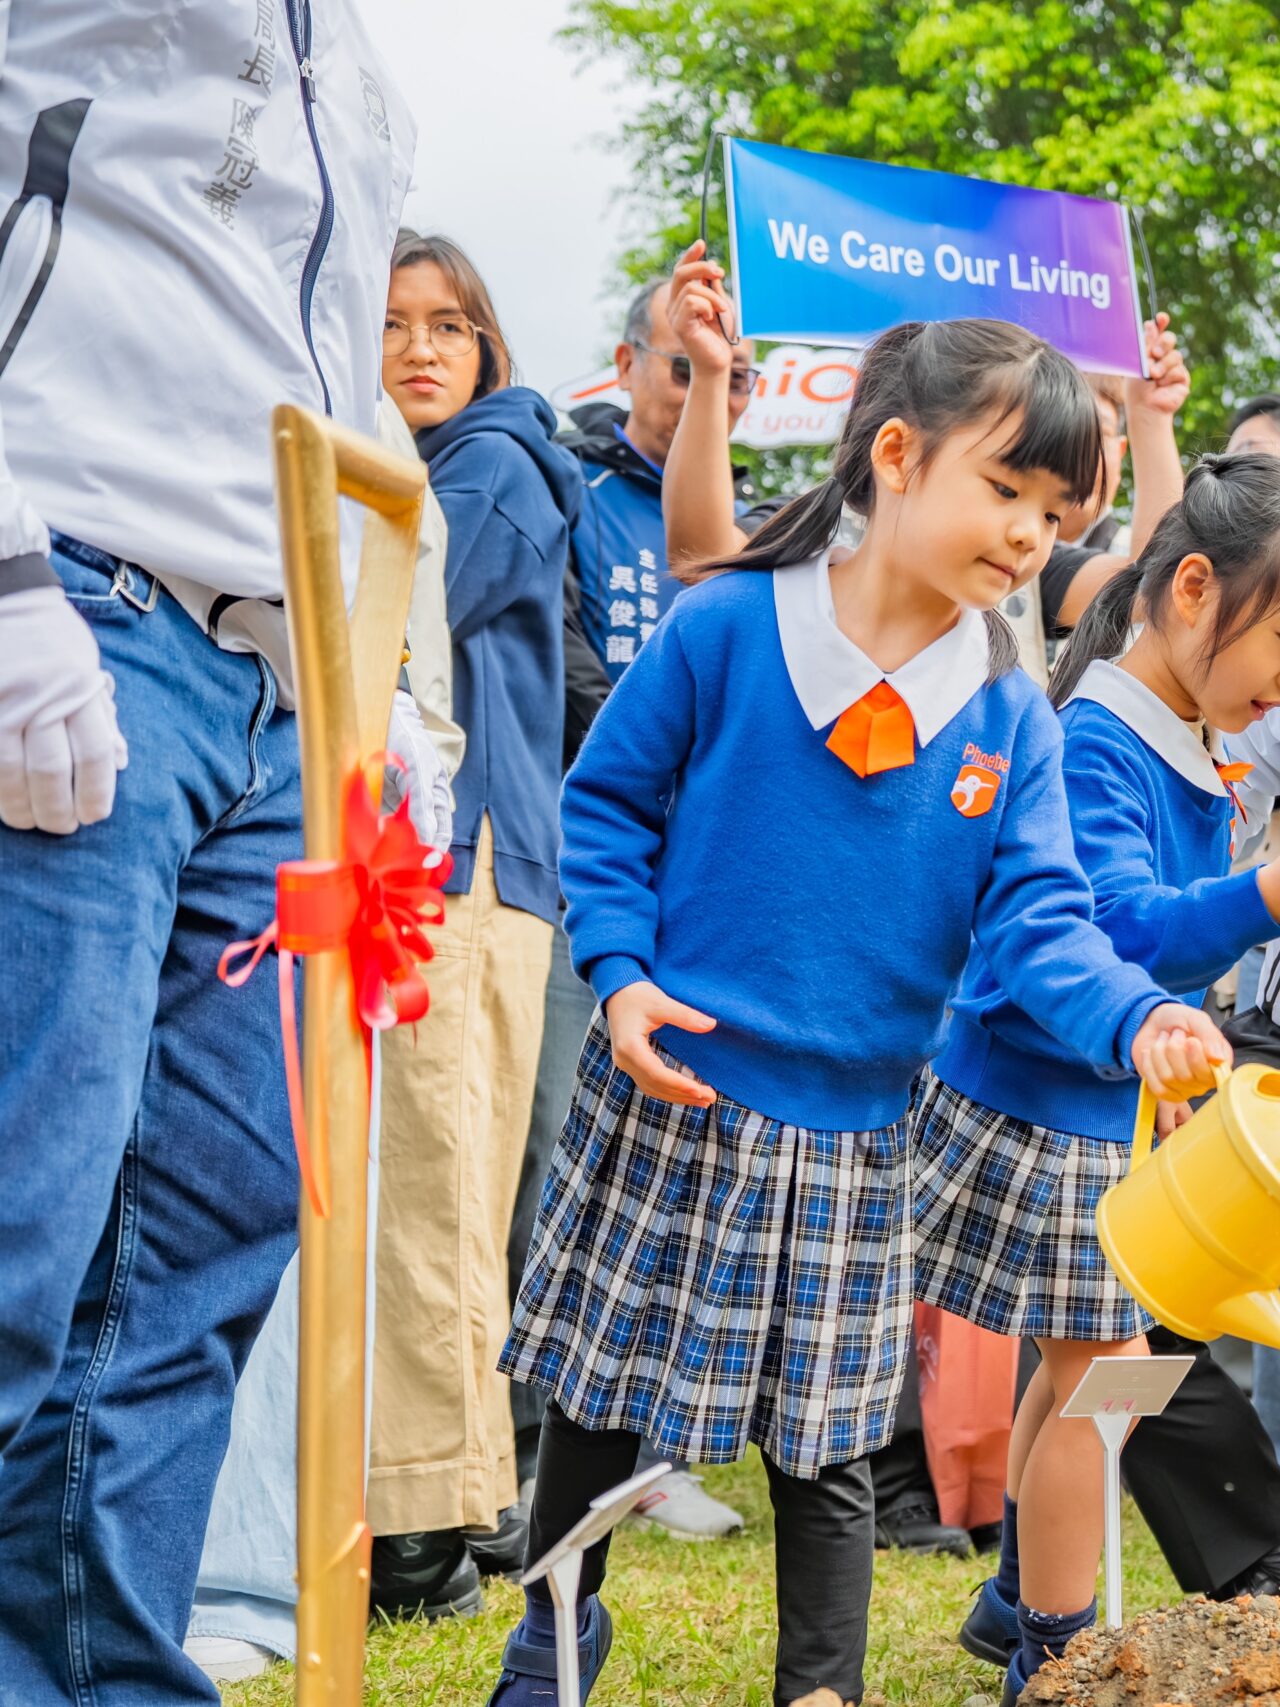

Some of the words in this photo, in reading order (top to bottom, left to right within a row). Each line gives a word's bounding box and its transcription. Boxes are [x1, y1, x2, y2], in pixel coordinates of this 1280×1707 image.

[767, 218, 830, 265] We
[840, 230, 926, 277] Care
[934, 244, 1001, 287] Our
[1009, 253, 1111, 310] Living
[962, 742, 1010, 773] Phoebe
